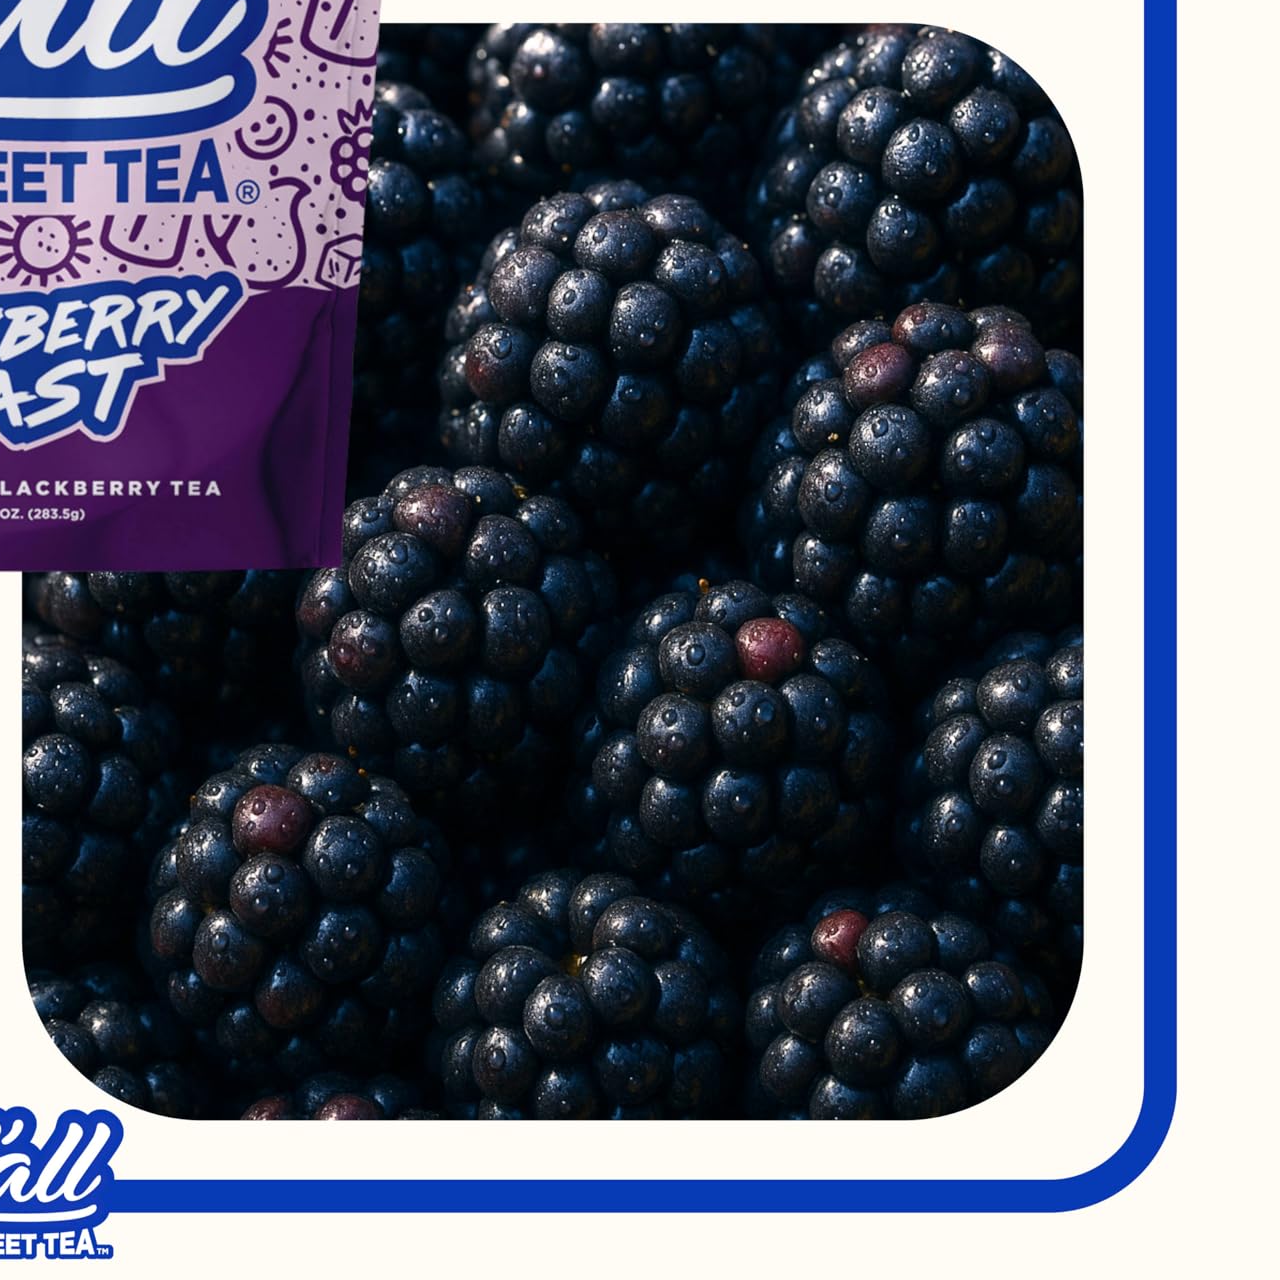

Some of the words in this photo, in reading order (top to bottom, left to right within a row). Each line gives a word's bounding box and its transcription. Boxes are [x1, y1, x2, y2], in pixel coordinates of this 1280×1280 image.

[170, 480, 221, 496] TEA
[0, 508, 24, 519] OZ.
[27, 508, 85, 521] (283.5g)
